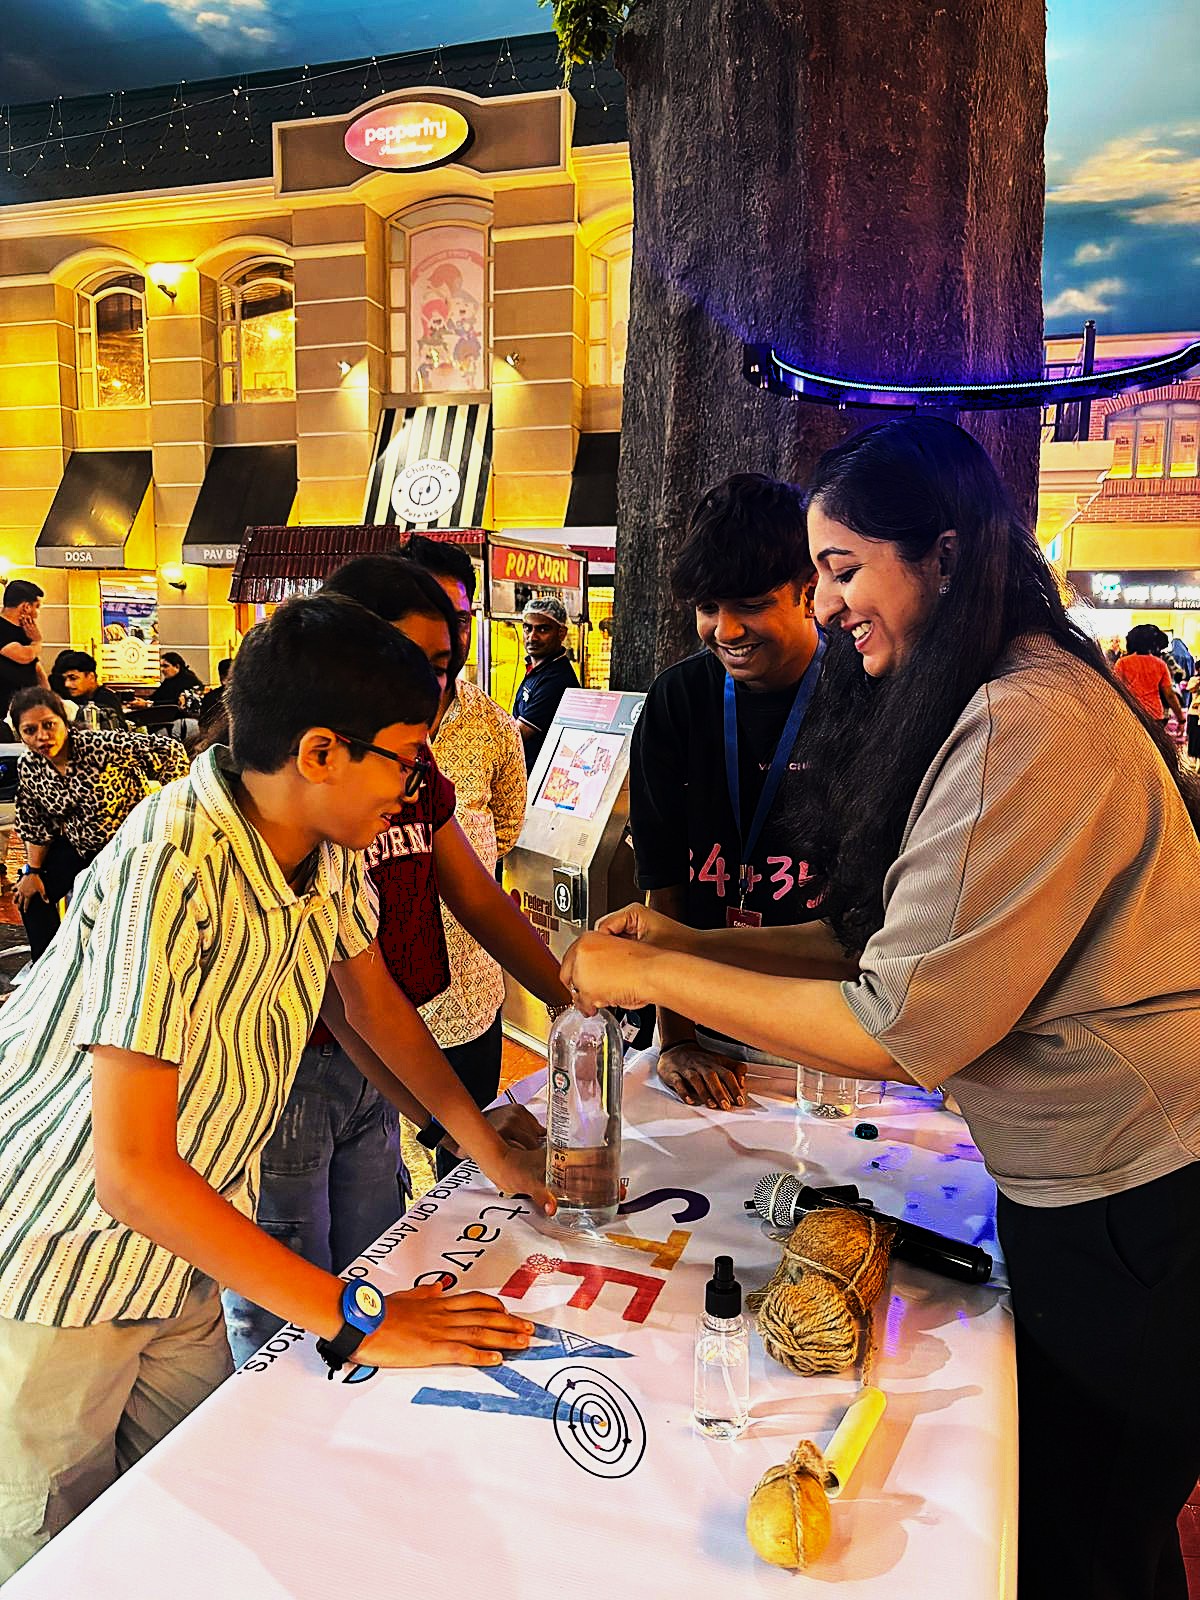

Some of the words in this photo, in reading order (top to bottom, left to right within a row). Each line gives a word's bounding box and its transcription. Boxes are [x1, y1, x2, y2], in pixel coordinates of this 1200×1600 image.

[365, 117, 447, 146] pepperfry
[64, 551, 93, 562] DOSA
[203, 549, 223, 560] PAV
[225, 549, 240, 560] BH
[408, 1202, 439, 1221] an
[360, 1222, 419, 1265] Army
